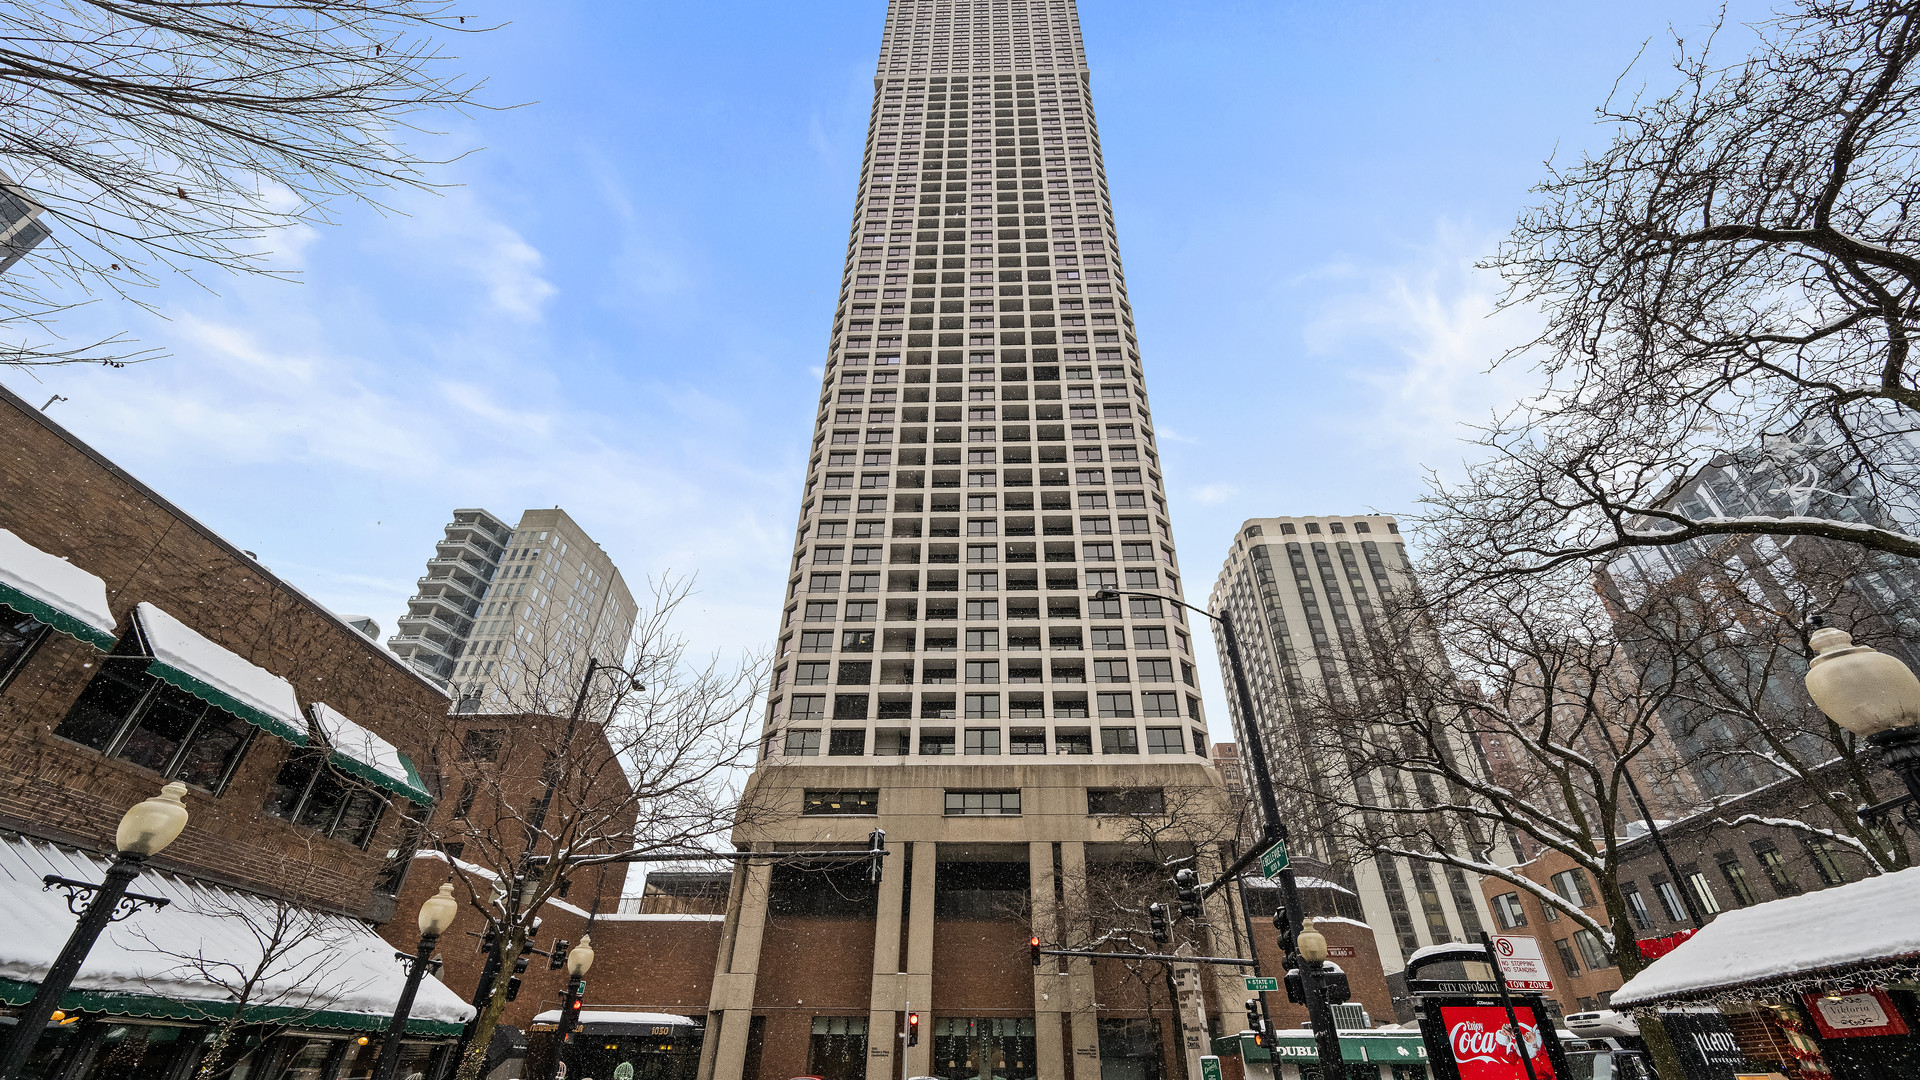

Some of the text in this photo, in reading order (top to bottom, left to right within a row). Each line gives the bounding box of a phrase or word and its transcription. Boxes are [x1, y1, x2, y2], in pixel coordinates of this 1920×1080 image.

[1264, 846, 1281, 867] BELLEVUE
[1510, 960, 1536, 968] STOPPING
[1513, 966, 1538, 974] STANDING
[1438, 982, 1458, 993] CITY
[1508, 980, 1550, 989] TOW ZONE
[1829, 1004, 1870, 1015] Viktoria
[1465, 1021, 1484, 1033] Enjoy
[1449, 1022, 1498, 1063] Coca
